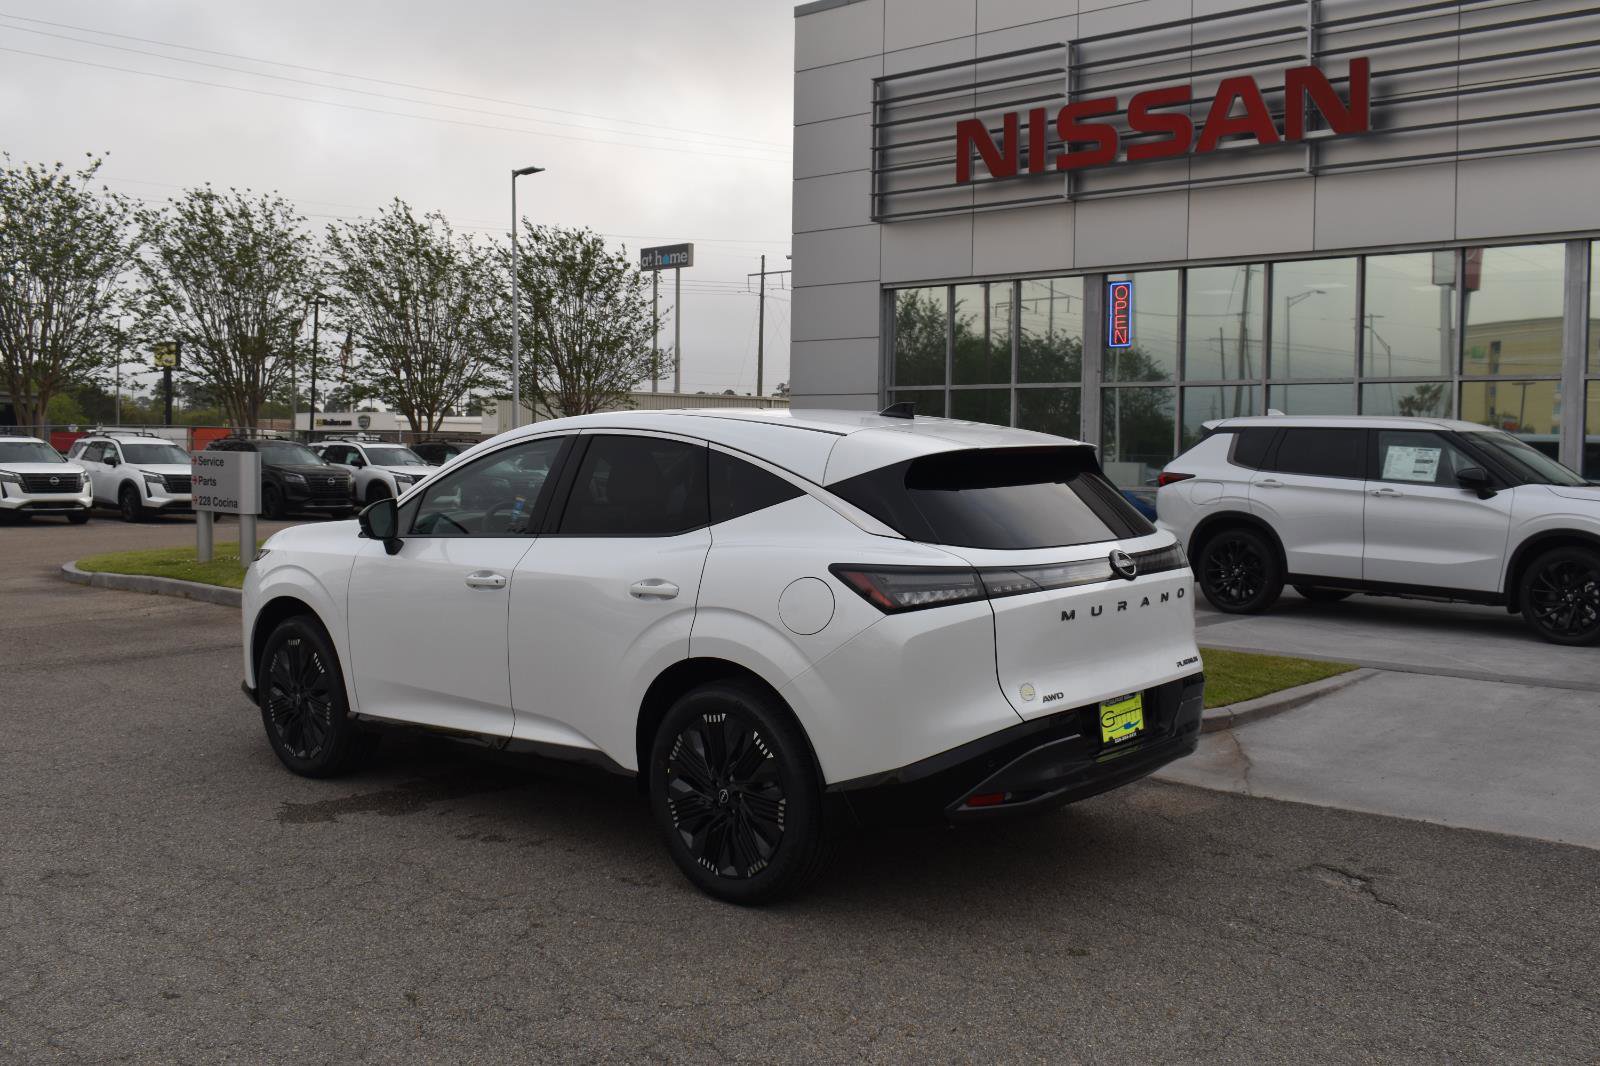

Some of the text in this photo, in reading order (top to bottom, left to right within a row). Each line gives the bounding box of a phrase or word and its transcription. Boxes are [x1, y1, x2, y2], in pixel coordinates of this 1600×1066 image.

[955, 56, 1370, 184] NISSAN
[641, 250, 688, 267] at home
[1113, 285, 1129, 344] OPEN
[198, 456, 224, 467] Service
[198, 476, 217, 486] Parts
[199, 496, 238, 508] 228 Cocina
[1060, 587, 1185, 622] MURANO
[1042, 691, 1064, 703] AWD
